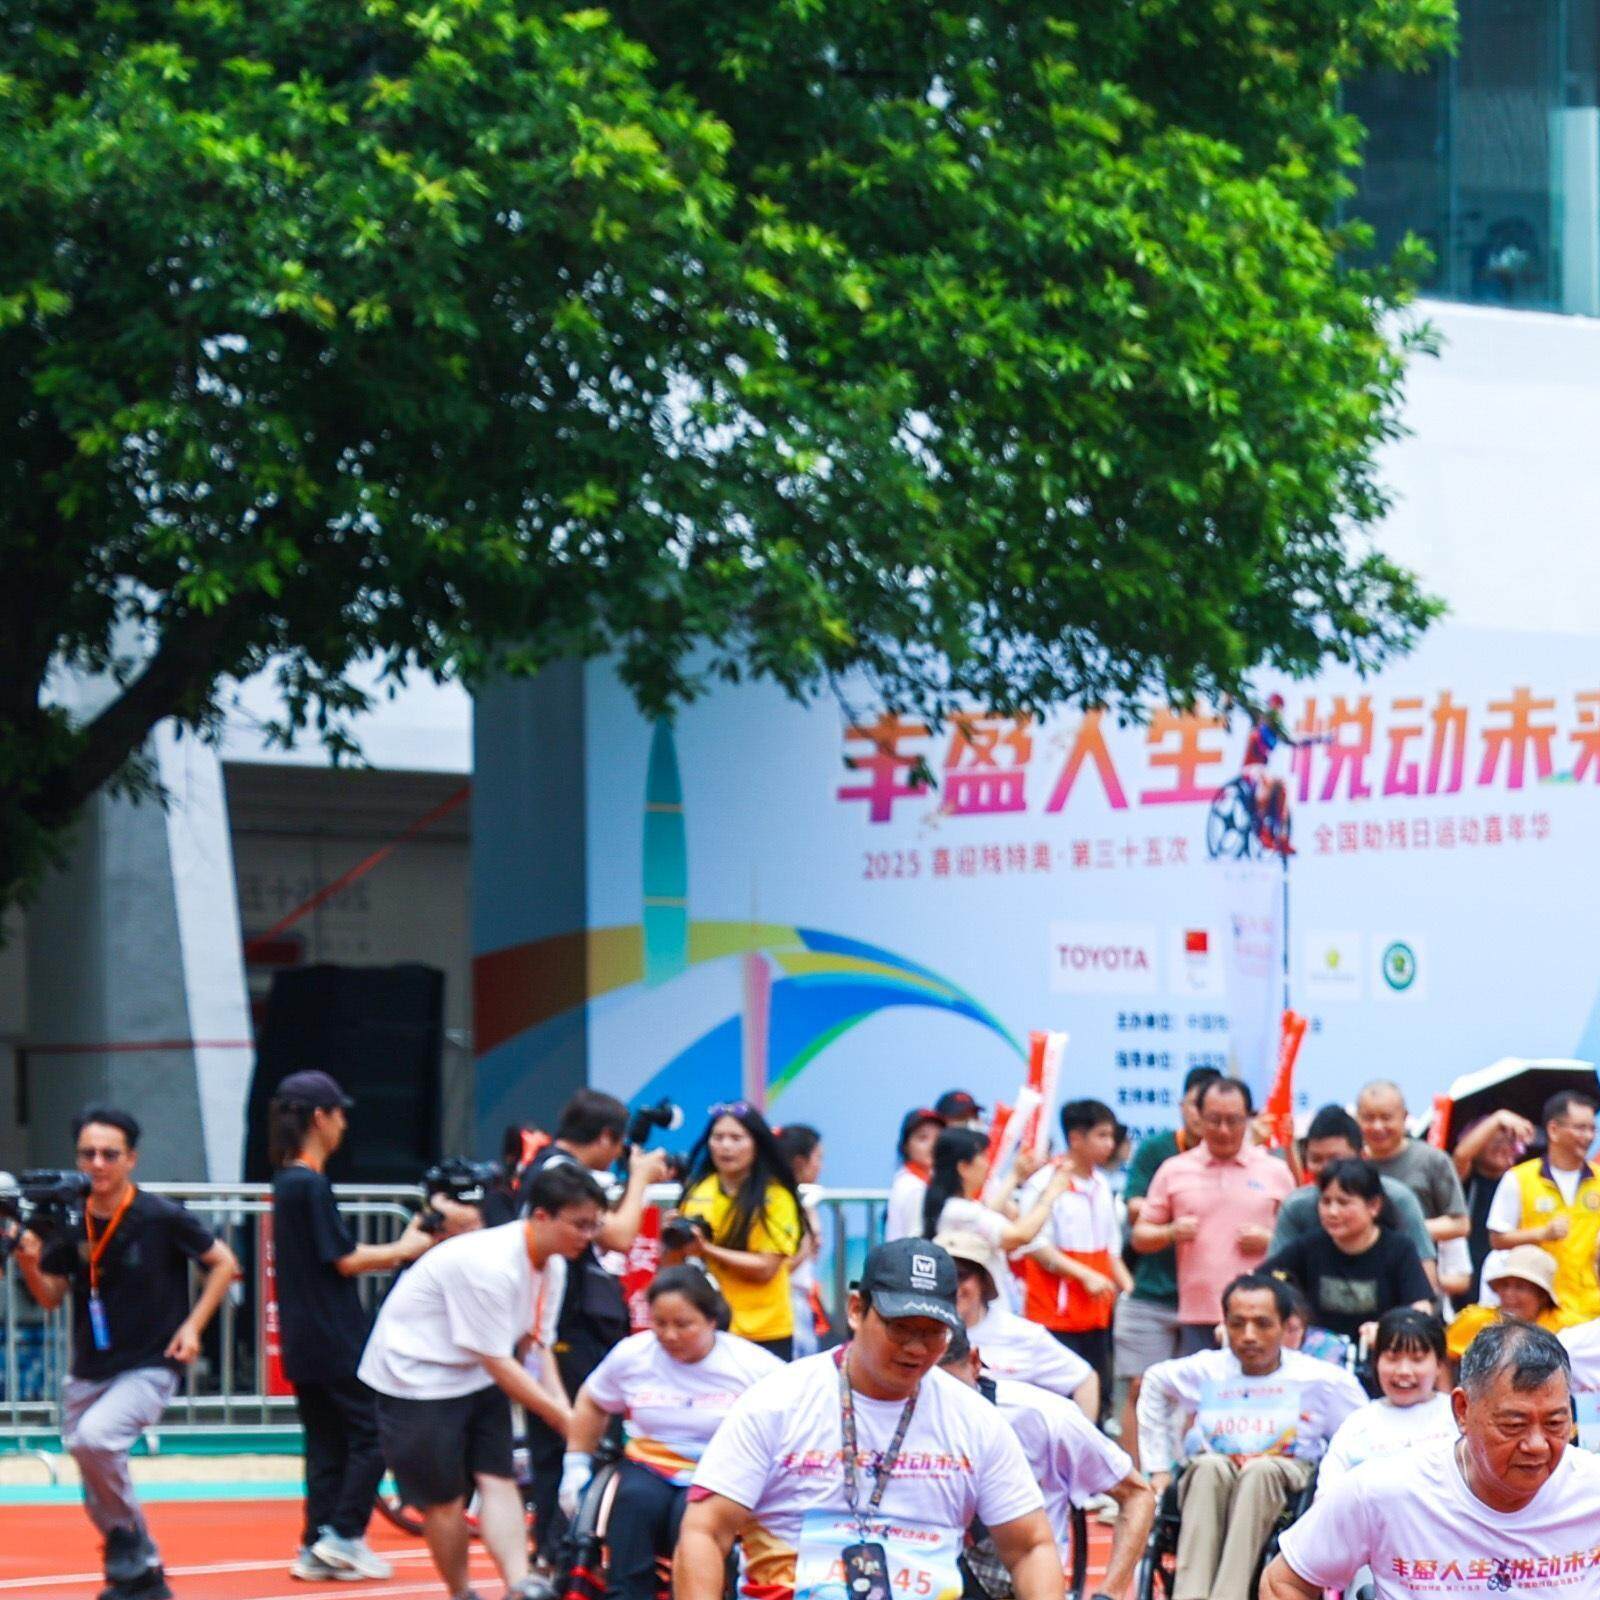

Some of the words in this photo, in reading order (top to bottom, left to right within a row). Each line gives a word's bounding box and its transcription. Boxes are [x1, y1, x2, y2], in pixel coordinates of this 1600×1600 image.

[837, 706, 1228, 823] 丰盈人生
[863, 850, 922, 881] 2025
[1056, 944, 1150, 971] TOYOTA
[826, 1559, 932, 1596] A45
[1391, 1556, 1493, 1581] 丰盈人生
